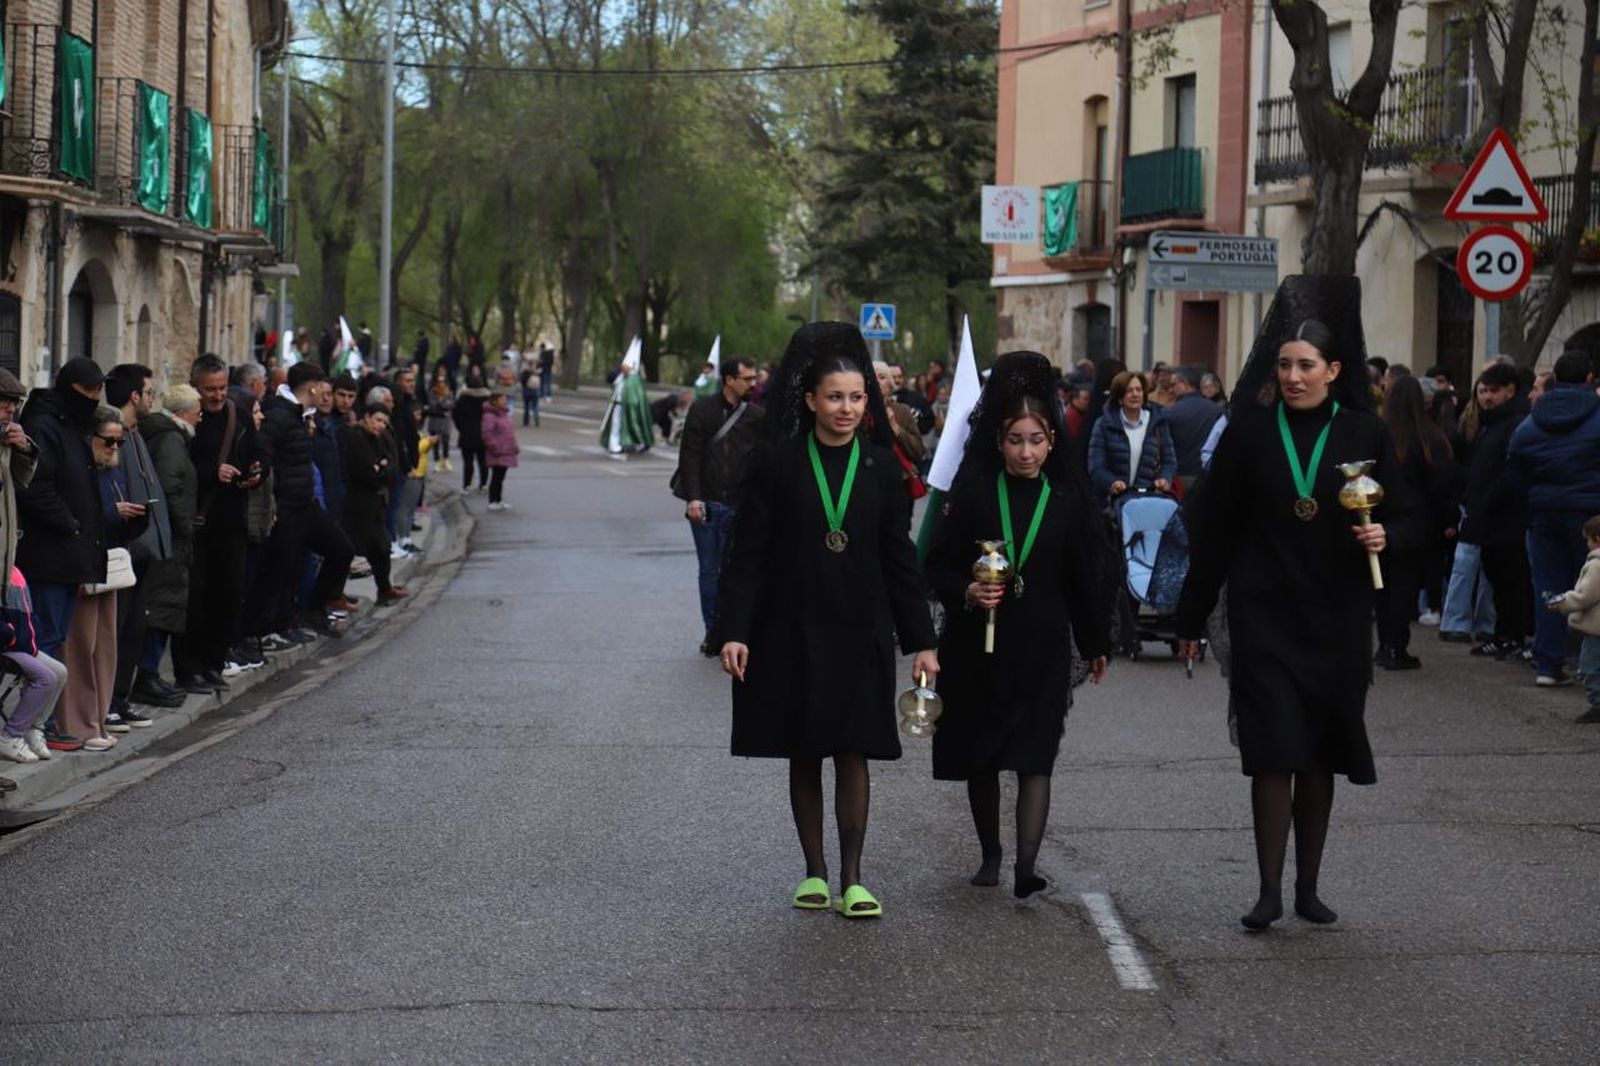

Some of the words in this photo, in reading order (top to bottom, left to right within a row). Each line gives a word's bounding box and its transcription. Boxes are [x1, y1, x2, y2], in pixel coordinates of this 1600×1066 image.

[1199, 239, 1277, 253] FERMOSELLE
[1210, 251, 1276, 263] PORTUGAL
[1475, 250, 1517, 275] 20
